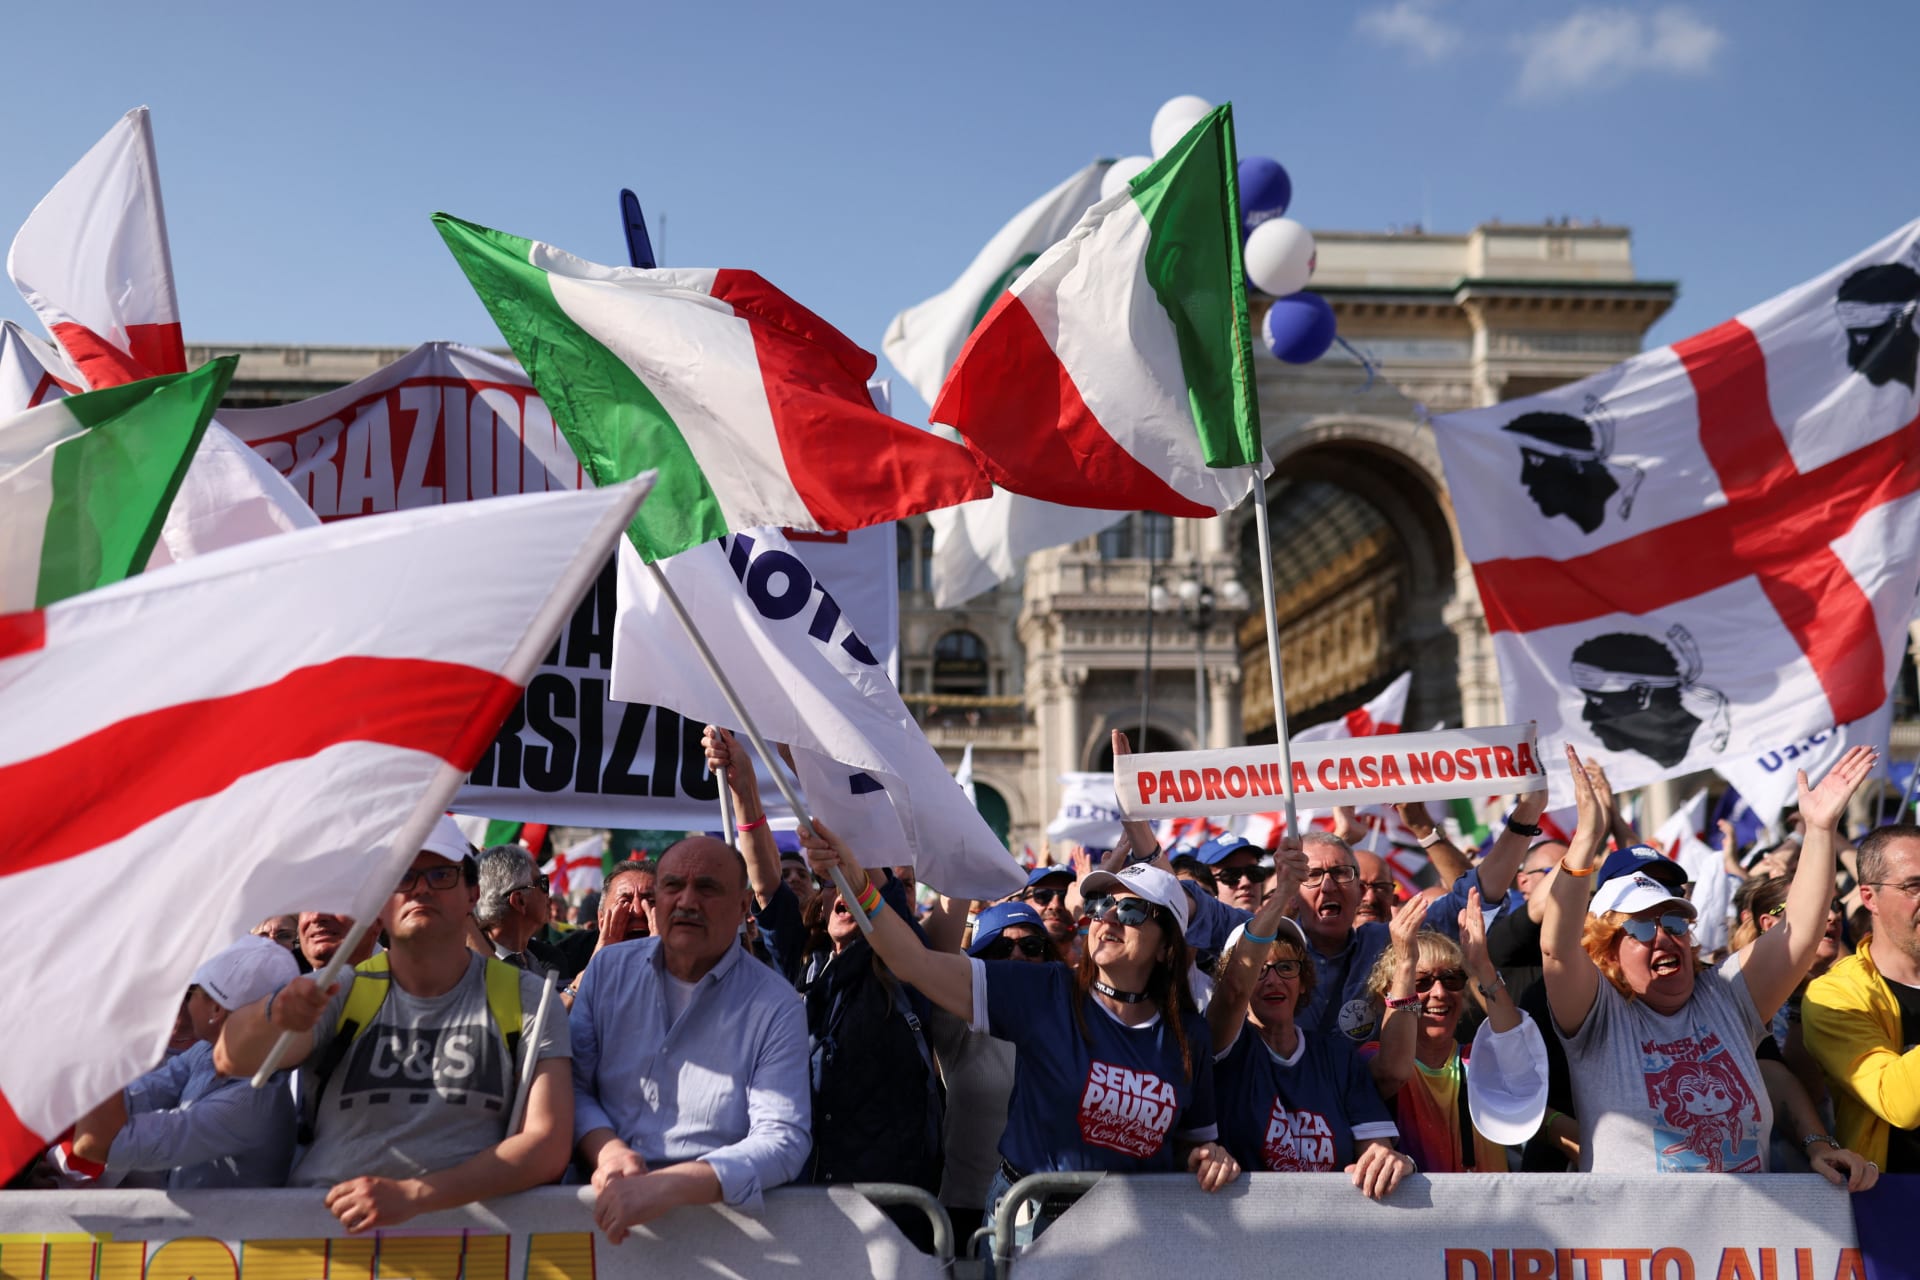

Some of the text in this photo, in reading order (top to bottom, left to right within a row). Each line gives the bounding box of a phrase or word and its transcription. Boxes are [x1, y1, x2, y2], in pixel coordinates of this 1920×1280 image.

[253, 386, 598, 514] RAZION
[466, 673, 735, 801] RSIZIO
[1137, 763, 1283, 805] PADRONI
[1291, 761, 1313, 793] A
[1317, 754, 1406, 791] CASA
[1407, 742, 1537, 785] NOSTRA
[368, 1034, 475, 1081] C&S
[1641, 1037, 1693, 1056] WNDER
[1082, 1082, 1174, 1134] PAURA
[1090, 1061, 1177, 1107] SENZA
[1272, 1096, 1333, 1137] SNZA
